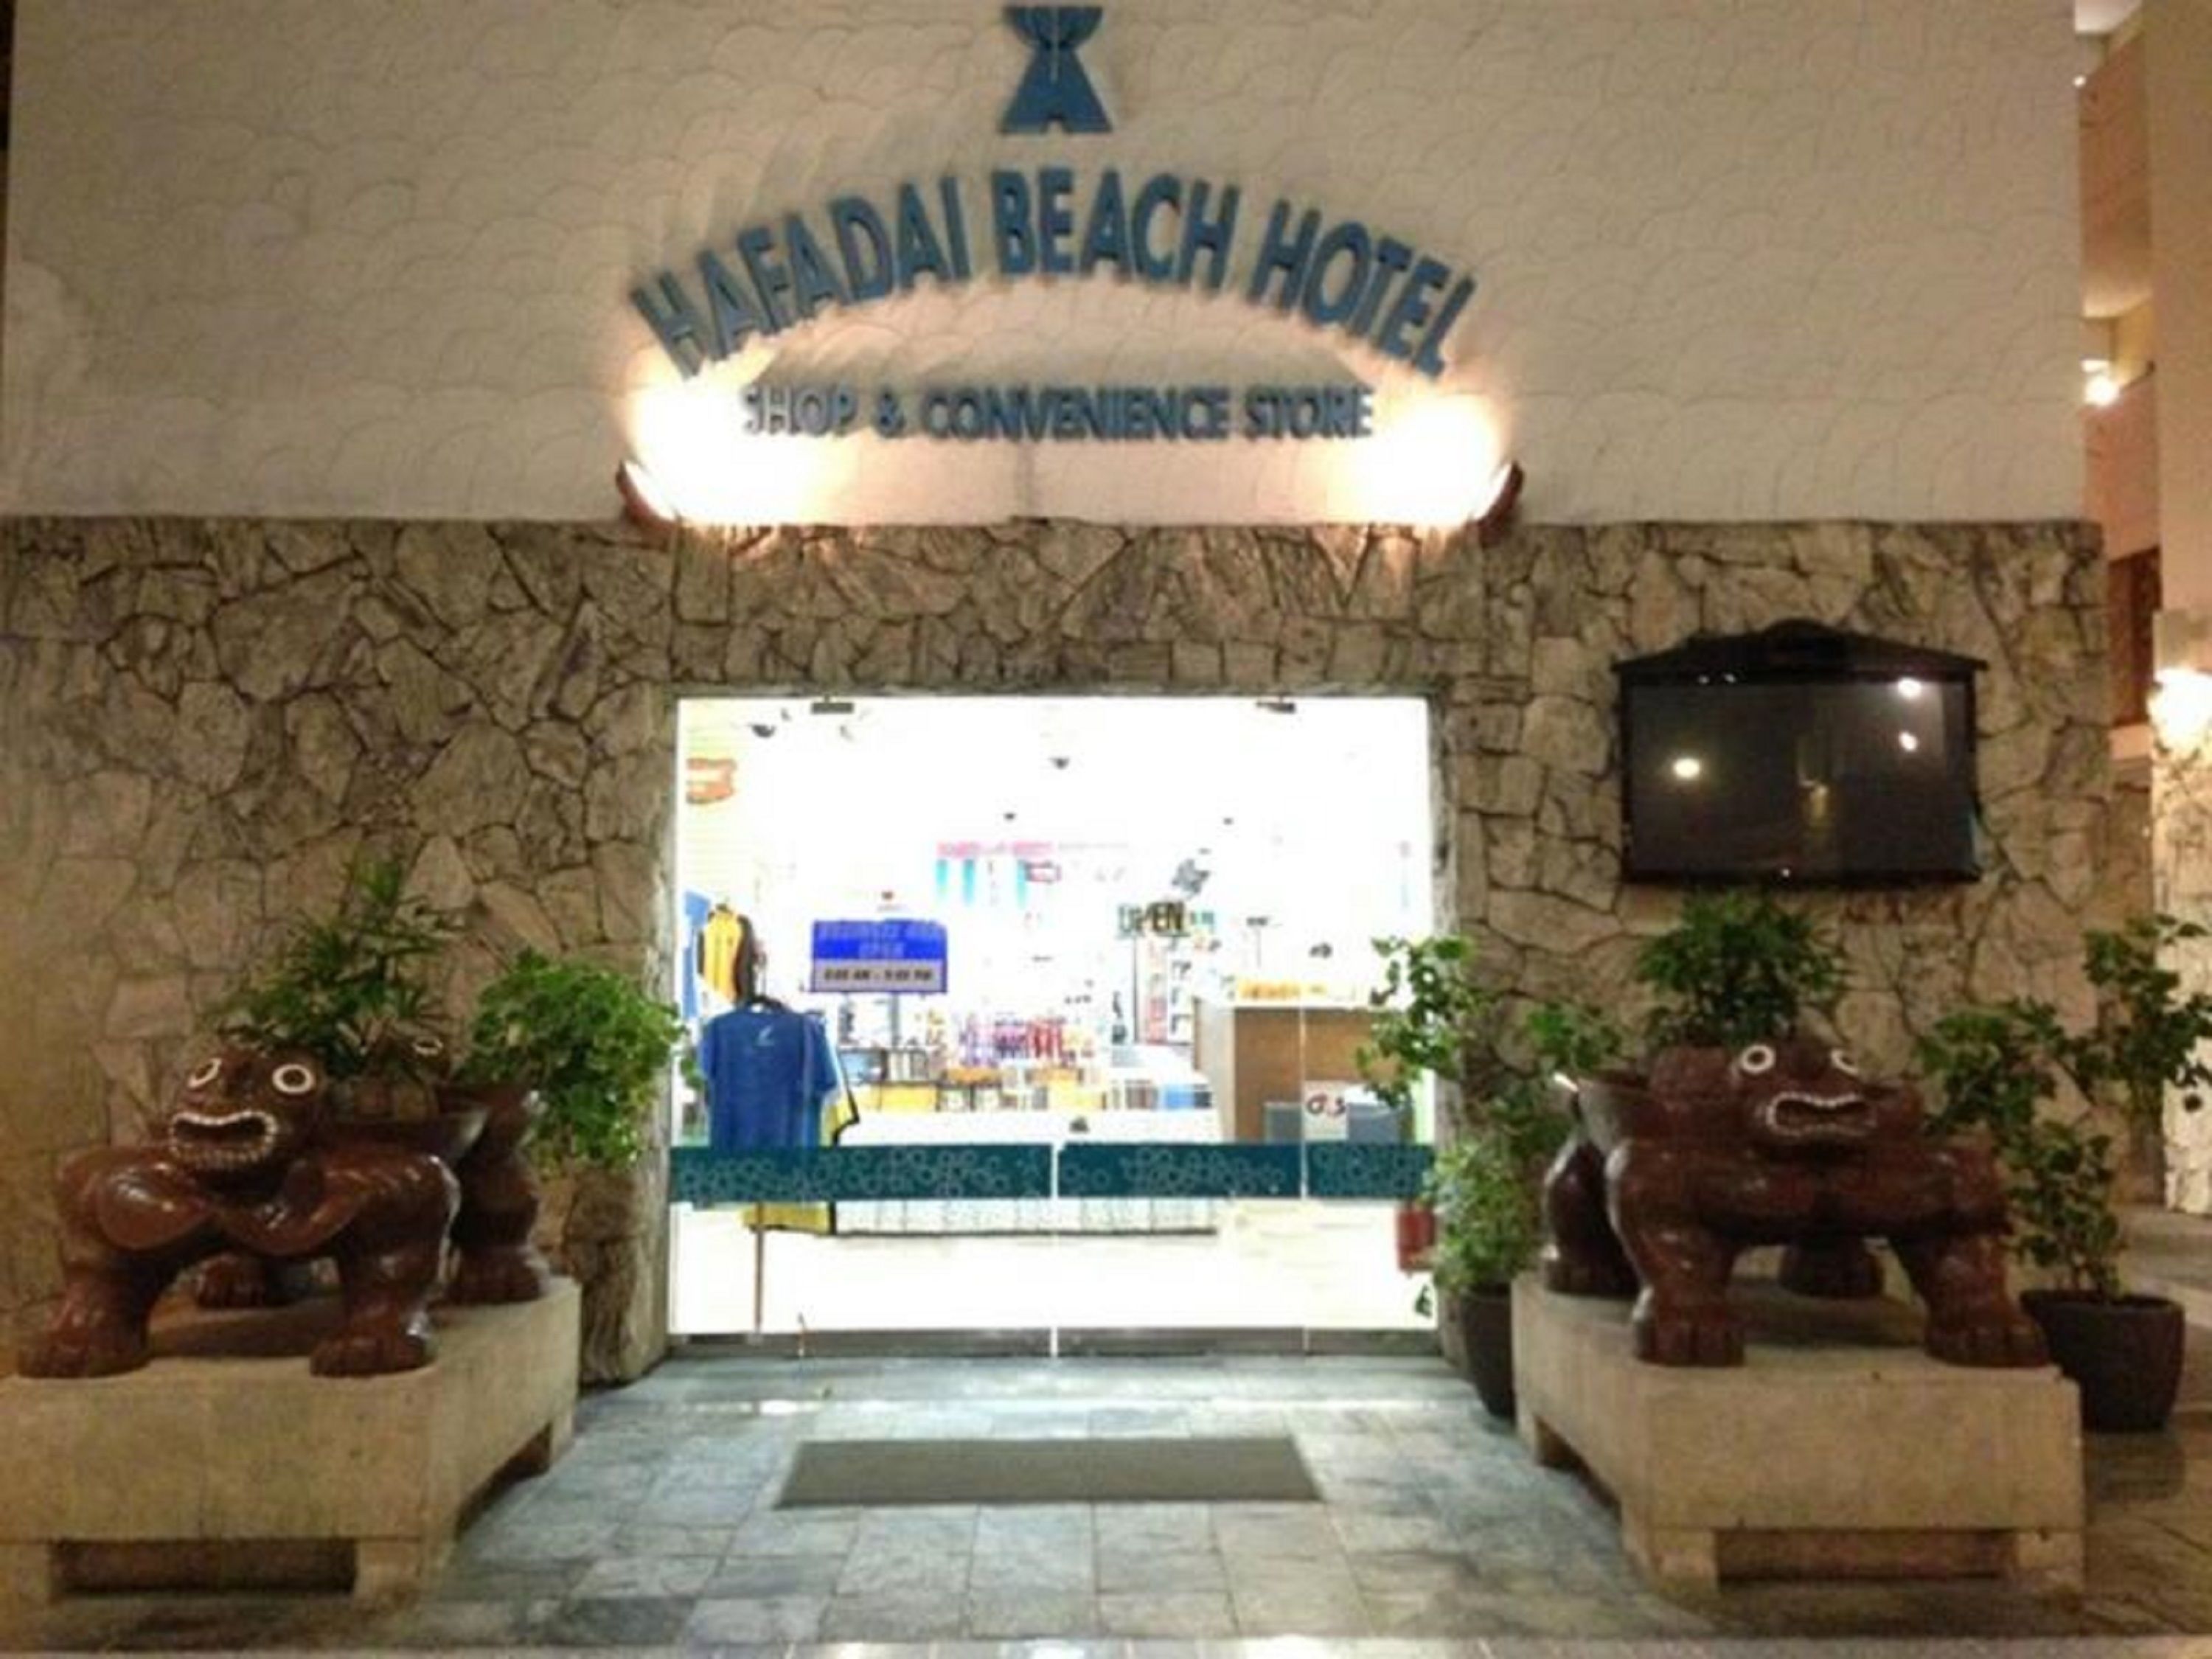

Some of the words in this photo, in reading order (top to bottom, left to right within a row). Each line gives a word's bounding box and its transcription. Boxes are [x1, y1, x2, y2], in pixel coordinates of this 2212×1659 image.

[630, 175, 971, 378] HAFADAI
[991, 166, 1240, 291] BEACH
[1248, 198, 1477, 377] HOTEL
[740, 386, 858, 437] SHOP
[874, 386, 905, 440] &
[925, 386, 1231, 442] CONVENIENCE
[1243, 385, 1374, 441] STORE
